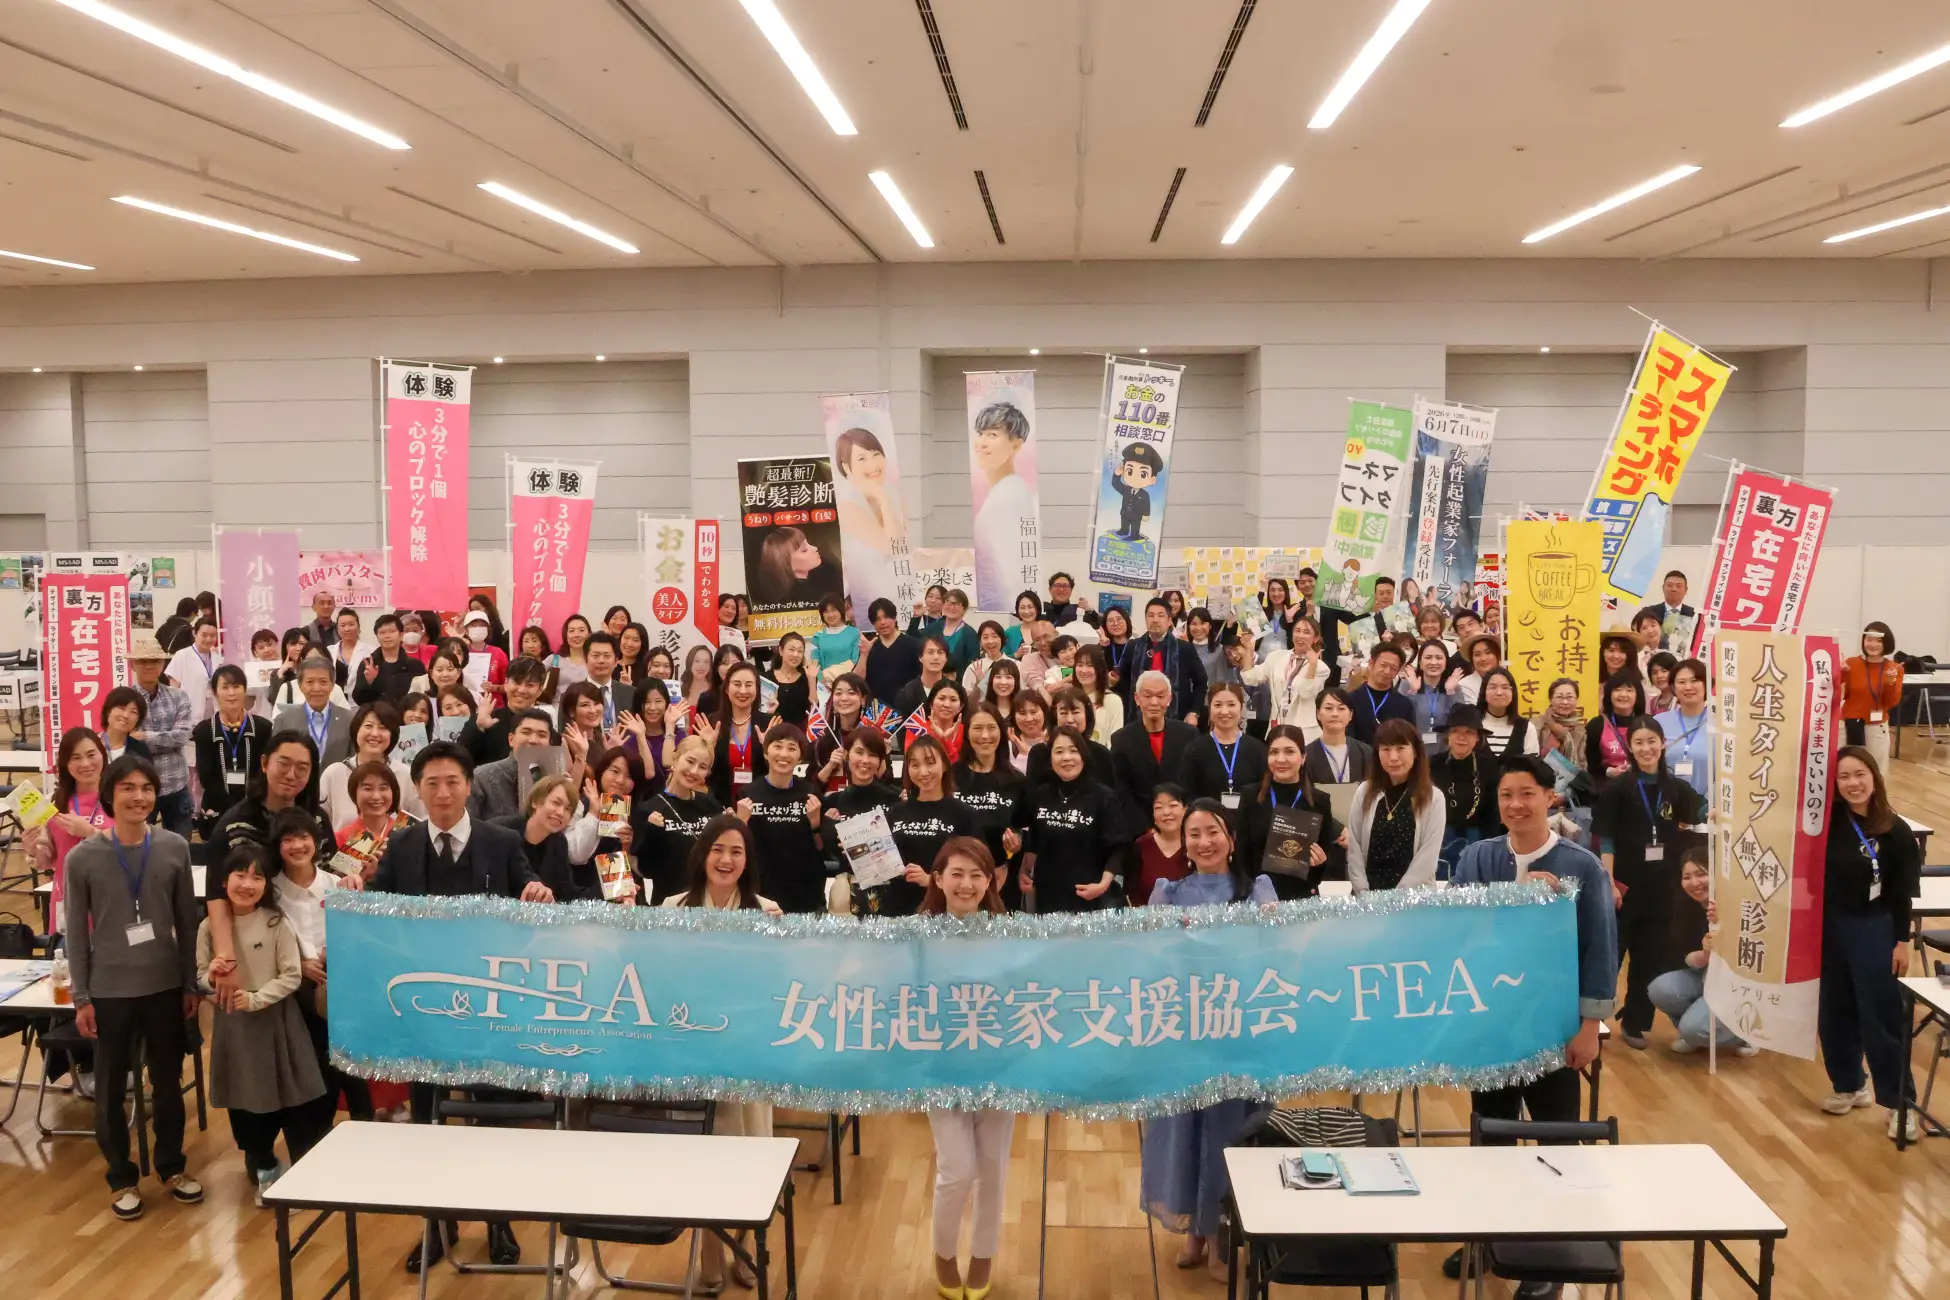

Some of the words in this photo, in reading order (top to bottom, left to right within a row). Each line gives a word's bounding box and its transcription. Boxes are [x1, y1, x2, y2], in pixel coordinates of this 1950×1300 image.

[405, 373, 457, 398] 体験
[1125, 384, 1165, 403] お金の
[1114, 424, 1166, 443] 相談窓口
[1610, 346, 1685, 496] コーティング
[1655, 367, 1717, 485] スマホ
[430, 408, 448, 499] 3分で1個
[530, 469, 582, 494] 体験
[766, 467, 811, 482] 超最新!
[408, 422, 428, 563] 心のブロック解除
[744, 481, 834, 509] 艶髪診断
[747, 515, 768, 525] うねり
[1416, 465, 1440, 582] 先行案内登録受付中
[1756, 494, 1797, 527] 裏方
[549, 504, 571, 593] 3分で1個
[655, 524, 686, 584] お金
[1535, 569, 1572, 587] COFFEE
[66, 589, 101, 612] 裏方
[657, 592, 683, 607] 美人
[658, 609, 682, 620] タイプ
[1724, 647, 1736, 678] 貯金
[1723, 693, 1735, 723] 副業
[1749, 644, 1788, 822] 人生タイプ
[892, 817, 955, 834] 正しさより楽しさ
[1036, 808, 1094, 826] 正しさより楽しさ
[1739, 836, 1780, 889] 無料
[1737, 899, 1769, 974] 診断
[476, 955, 659, 1027] FEA
[1730, 981, 1782, 1006] レアリゼ
[489, 1021, 524, 1034] Female
[526, 1023, 596, 1038] Entrepreneurs
[598, 1026, 653, 1040] Association
